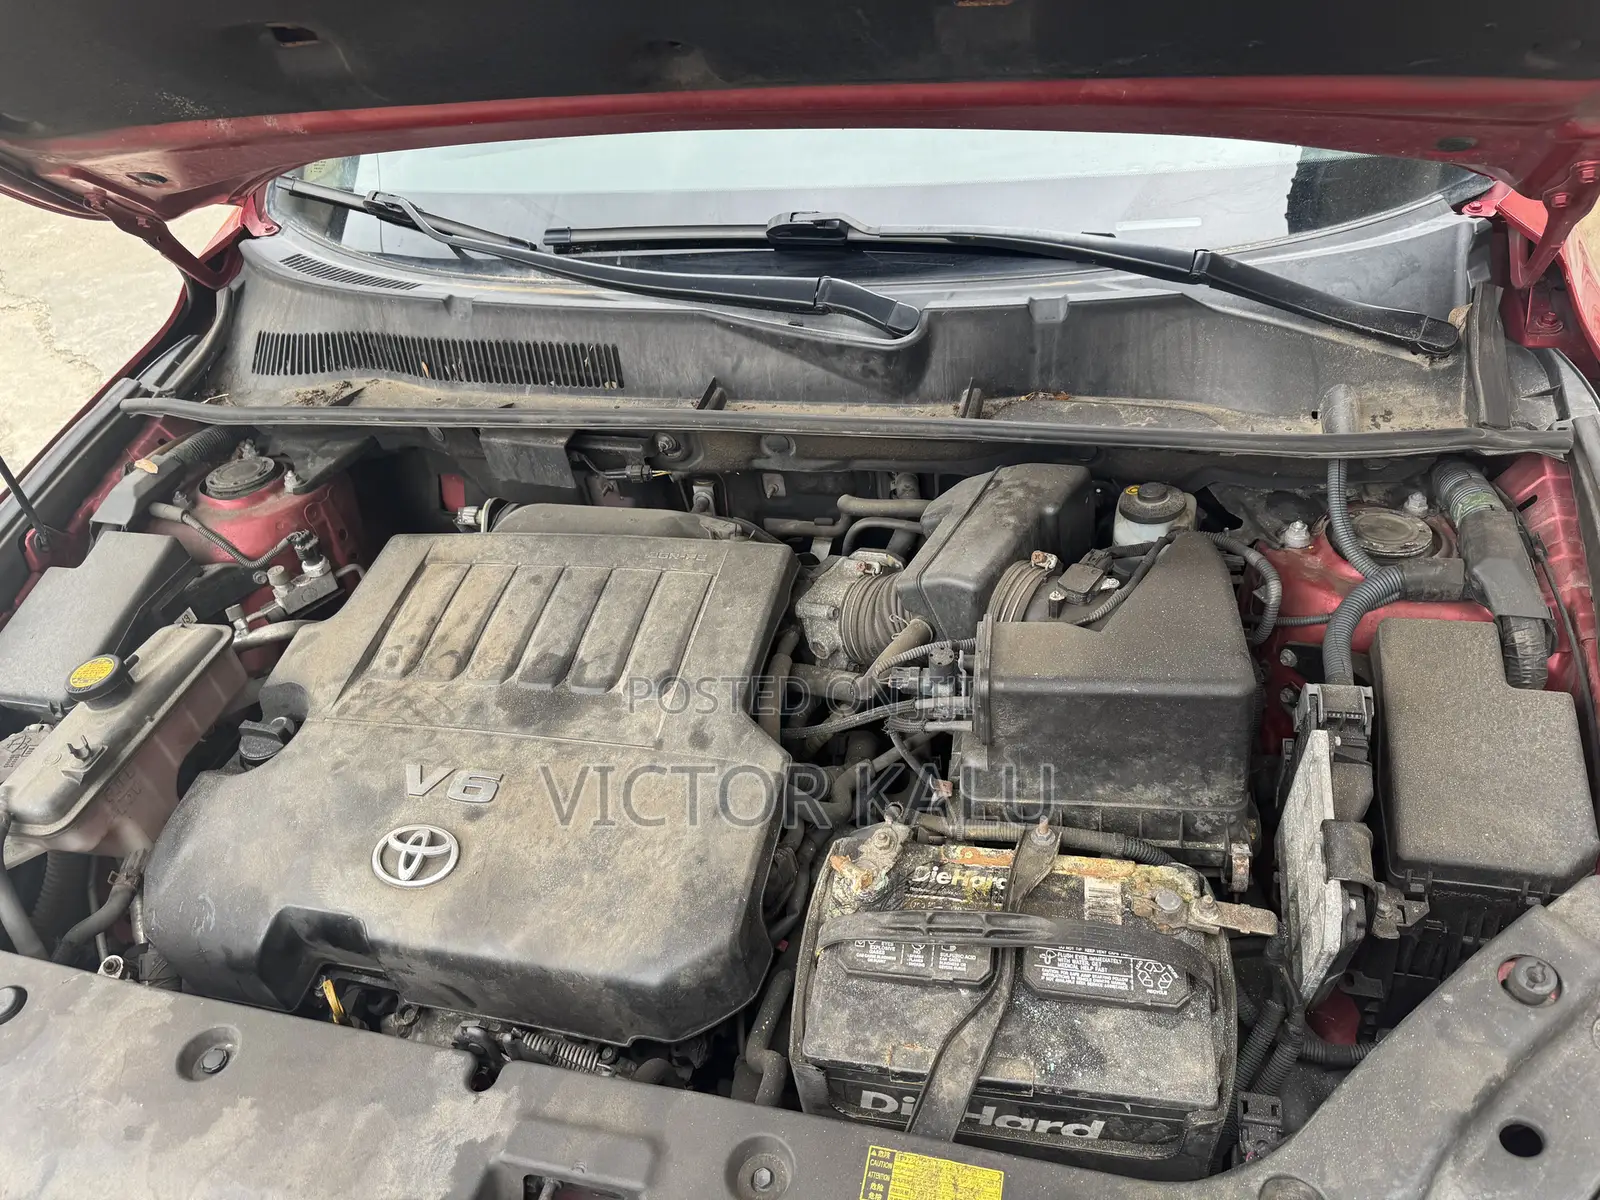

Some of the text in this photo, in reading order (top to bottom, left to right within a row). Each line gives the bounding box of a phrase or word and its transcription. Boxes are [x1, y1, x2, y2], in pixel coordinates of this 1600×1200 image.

[405, 763, 504, 804] V6
[861, 1089, 1106, 1139] DiHard
[870, 1158, 893, 1170] CAUTION
